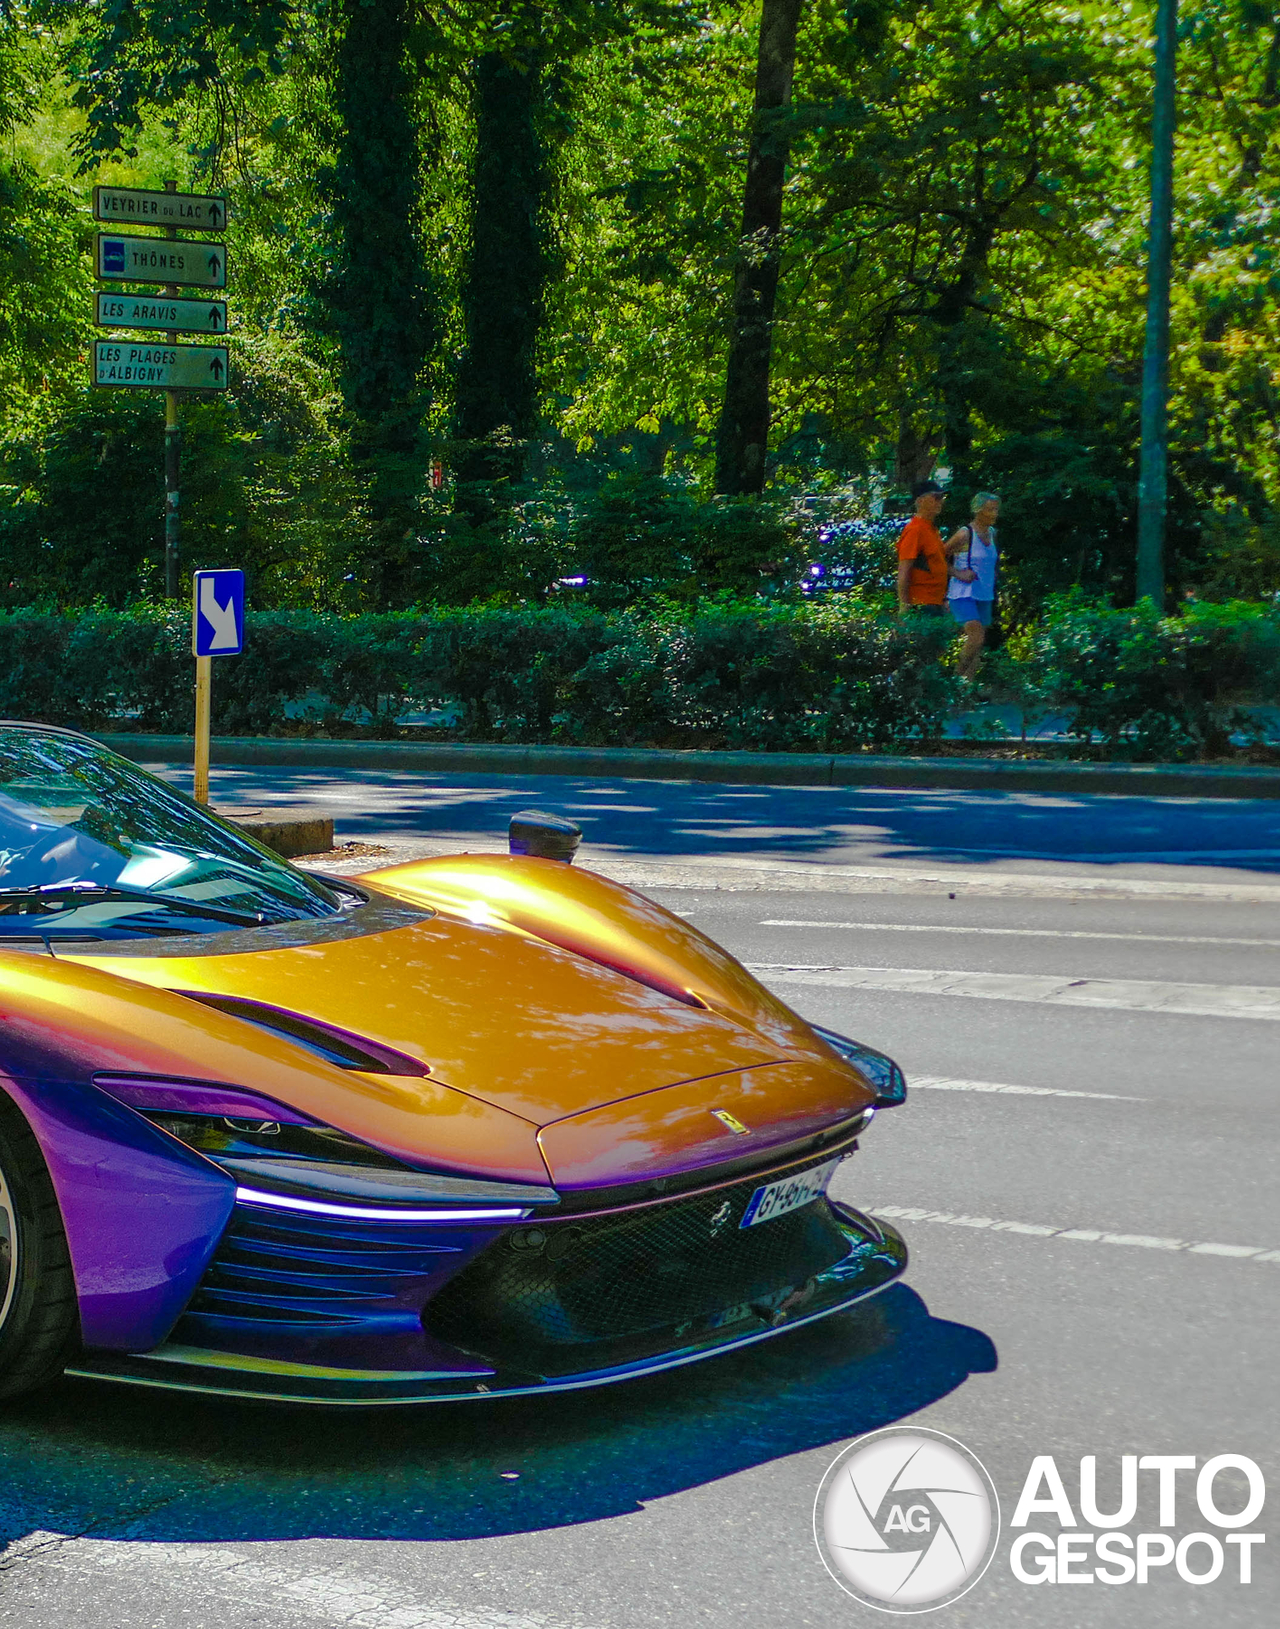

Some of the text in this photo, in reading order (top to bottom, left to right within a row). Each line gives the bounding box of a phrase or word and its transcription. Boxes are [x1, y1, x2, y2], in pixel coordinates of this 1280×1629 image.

[103, 196, 202, 219] VEYRIER DU LAC
[132, 251, 185, 269] THÔNES
[103, 302, 177, 321] LES ARAVIS
[100, 347, 177, 365] LES PLAGES
